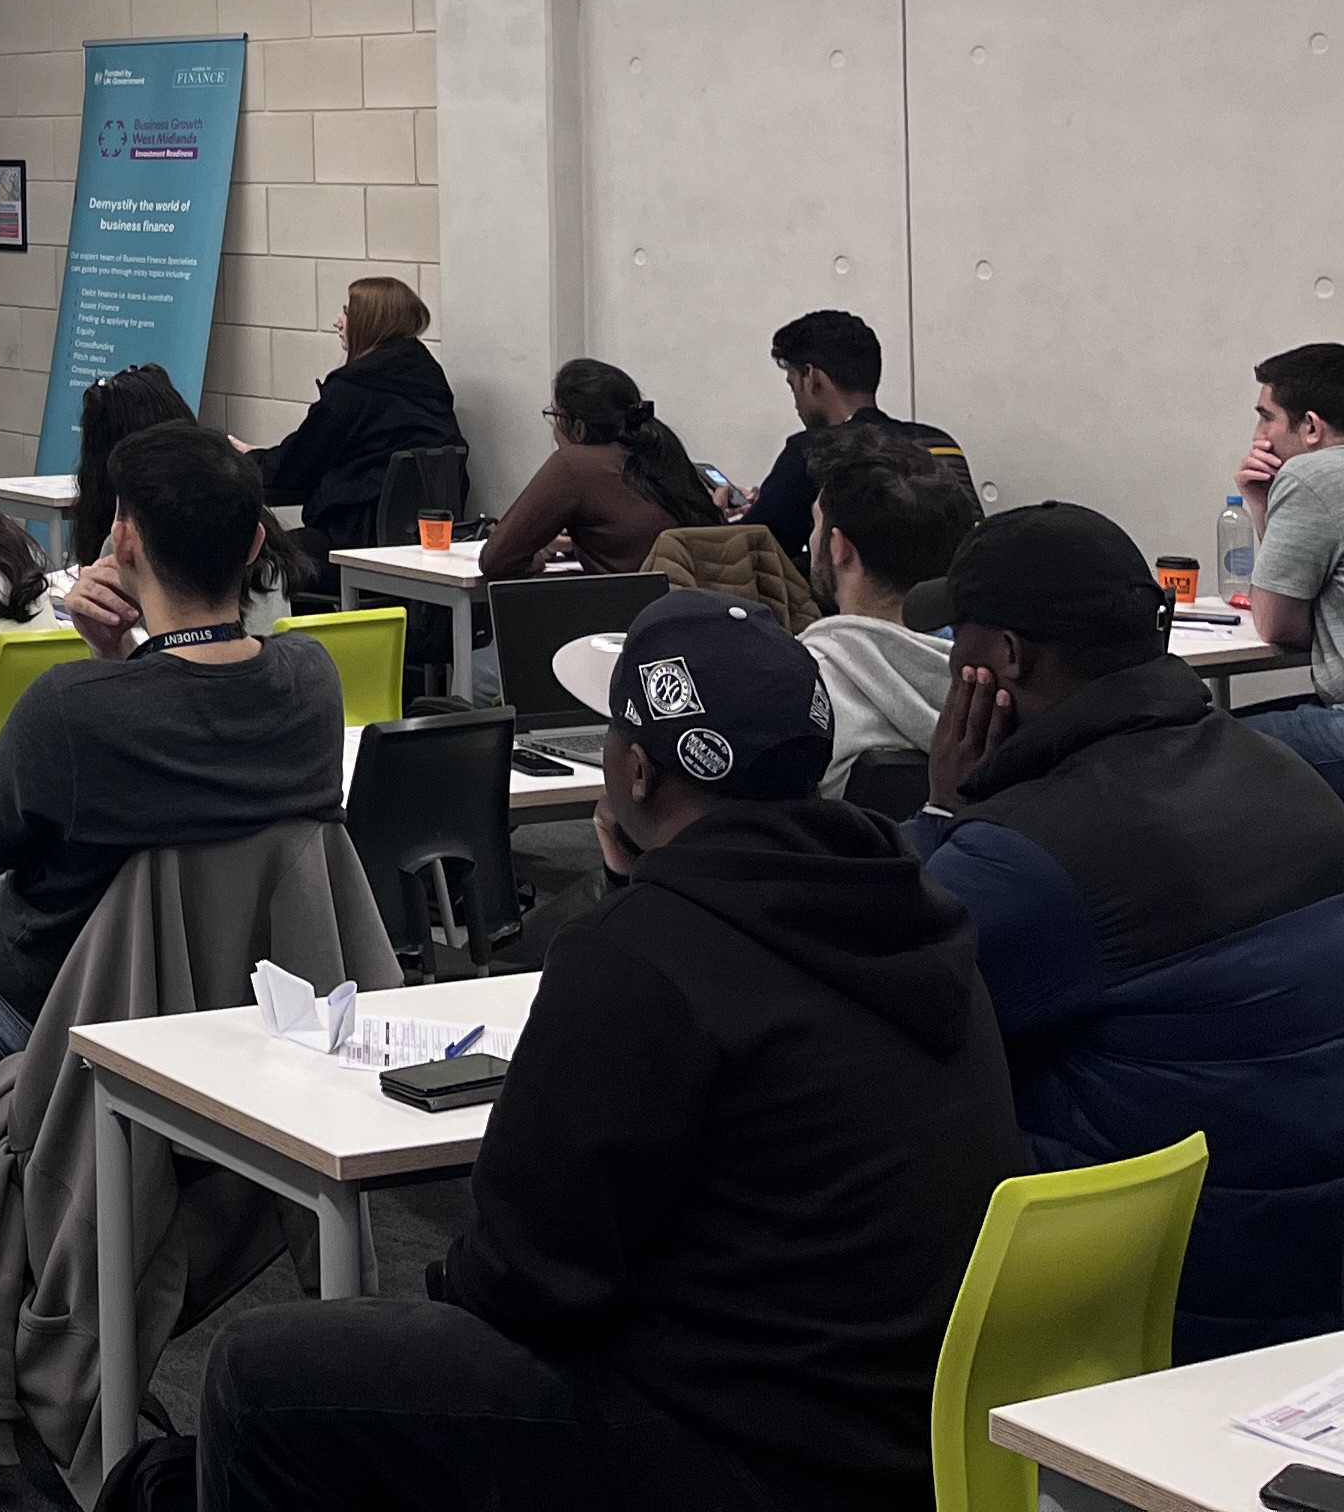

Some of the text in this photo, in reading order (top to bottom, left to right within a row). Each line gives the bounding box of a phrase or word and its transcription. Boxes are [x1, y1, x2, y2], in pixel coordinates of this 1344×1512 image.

[177, 71, 225, 84] FINANCE
[133, 118, 203, 130] Business Growth
[132, 133, 197, 145] West Midlands
[89, 197, 191, 214] Demystify the world of
[100, 218, 175, 233] business finance
[164, 629, 213, 647] STUDENT
